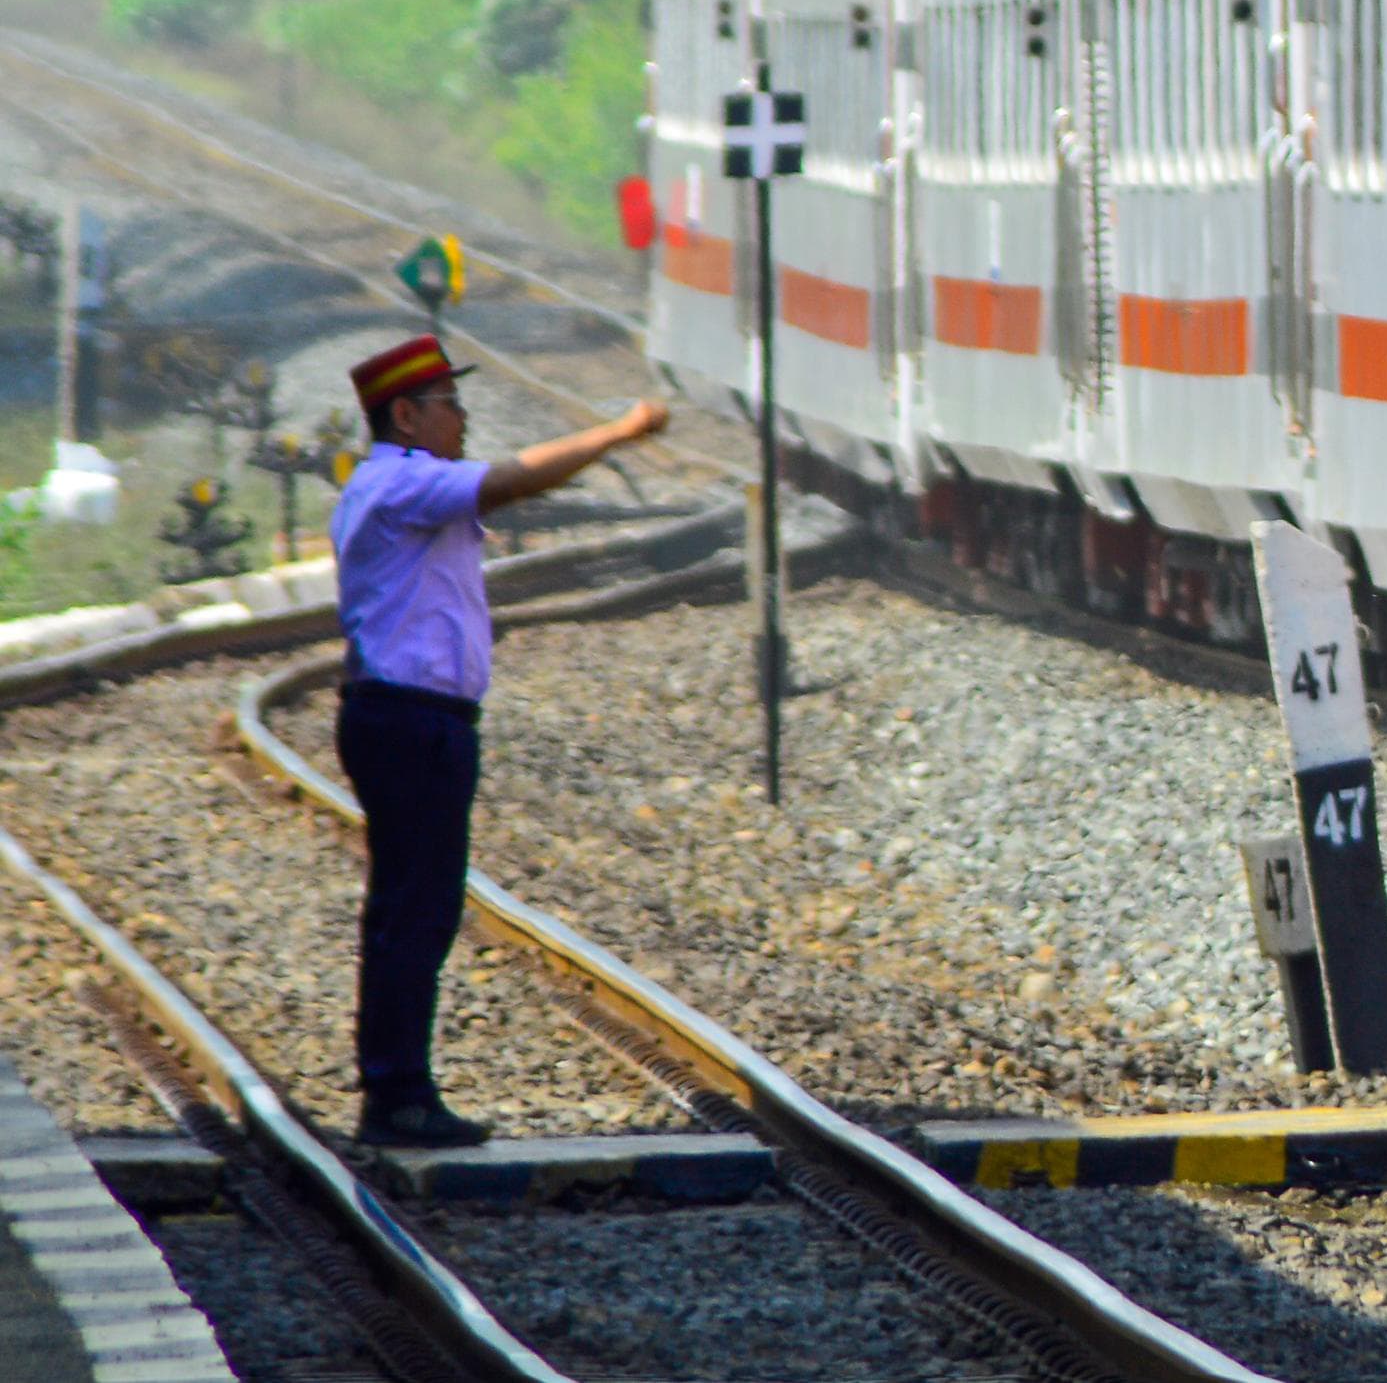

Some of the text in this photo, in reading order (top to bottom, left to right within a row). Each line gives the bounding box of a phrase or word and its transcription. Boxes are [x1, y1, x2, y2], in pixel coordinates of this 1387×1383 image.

[1291, 642, 1339, 700] 47
[1313, 785, 1368, 846] 47
[1264, 857, 1294, 921] 47
